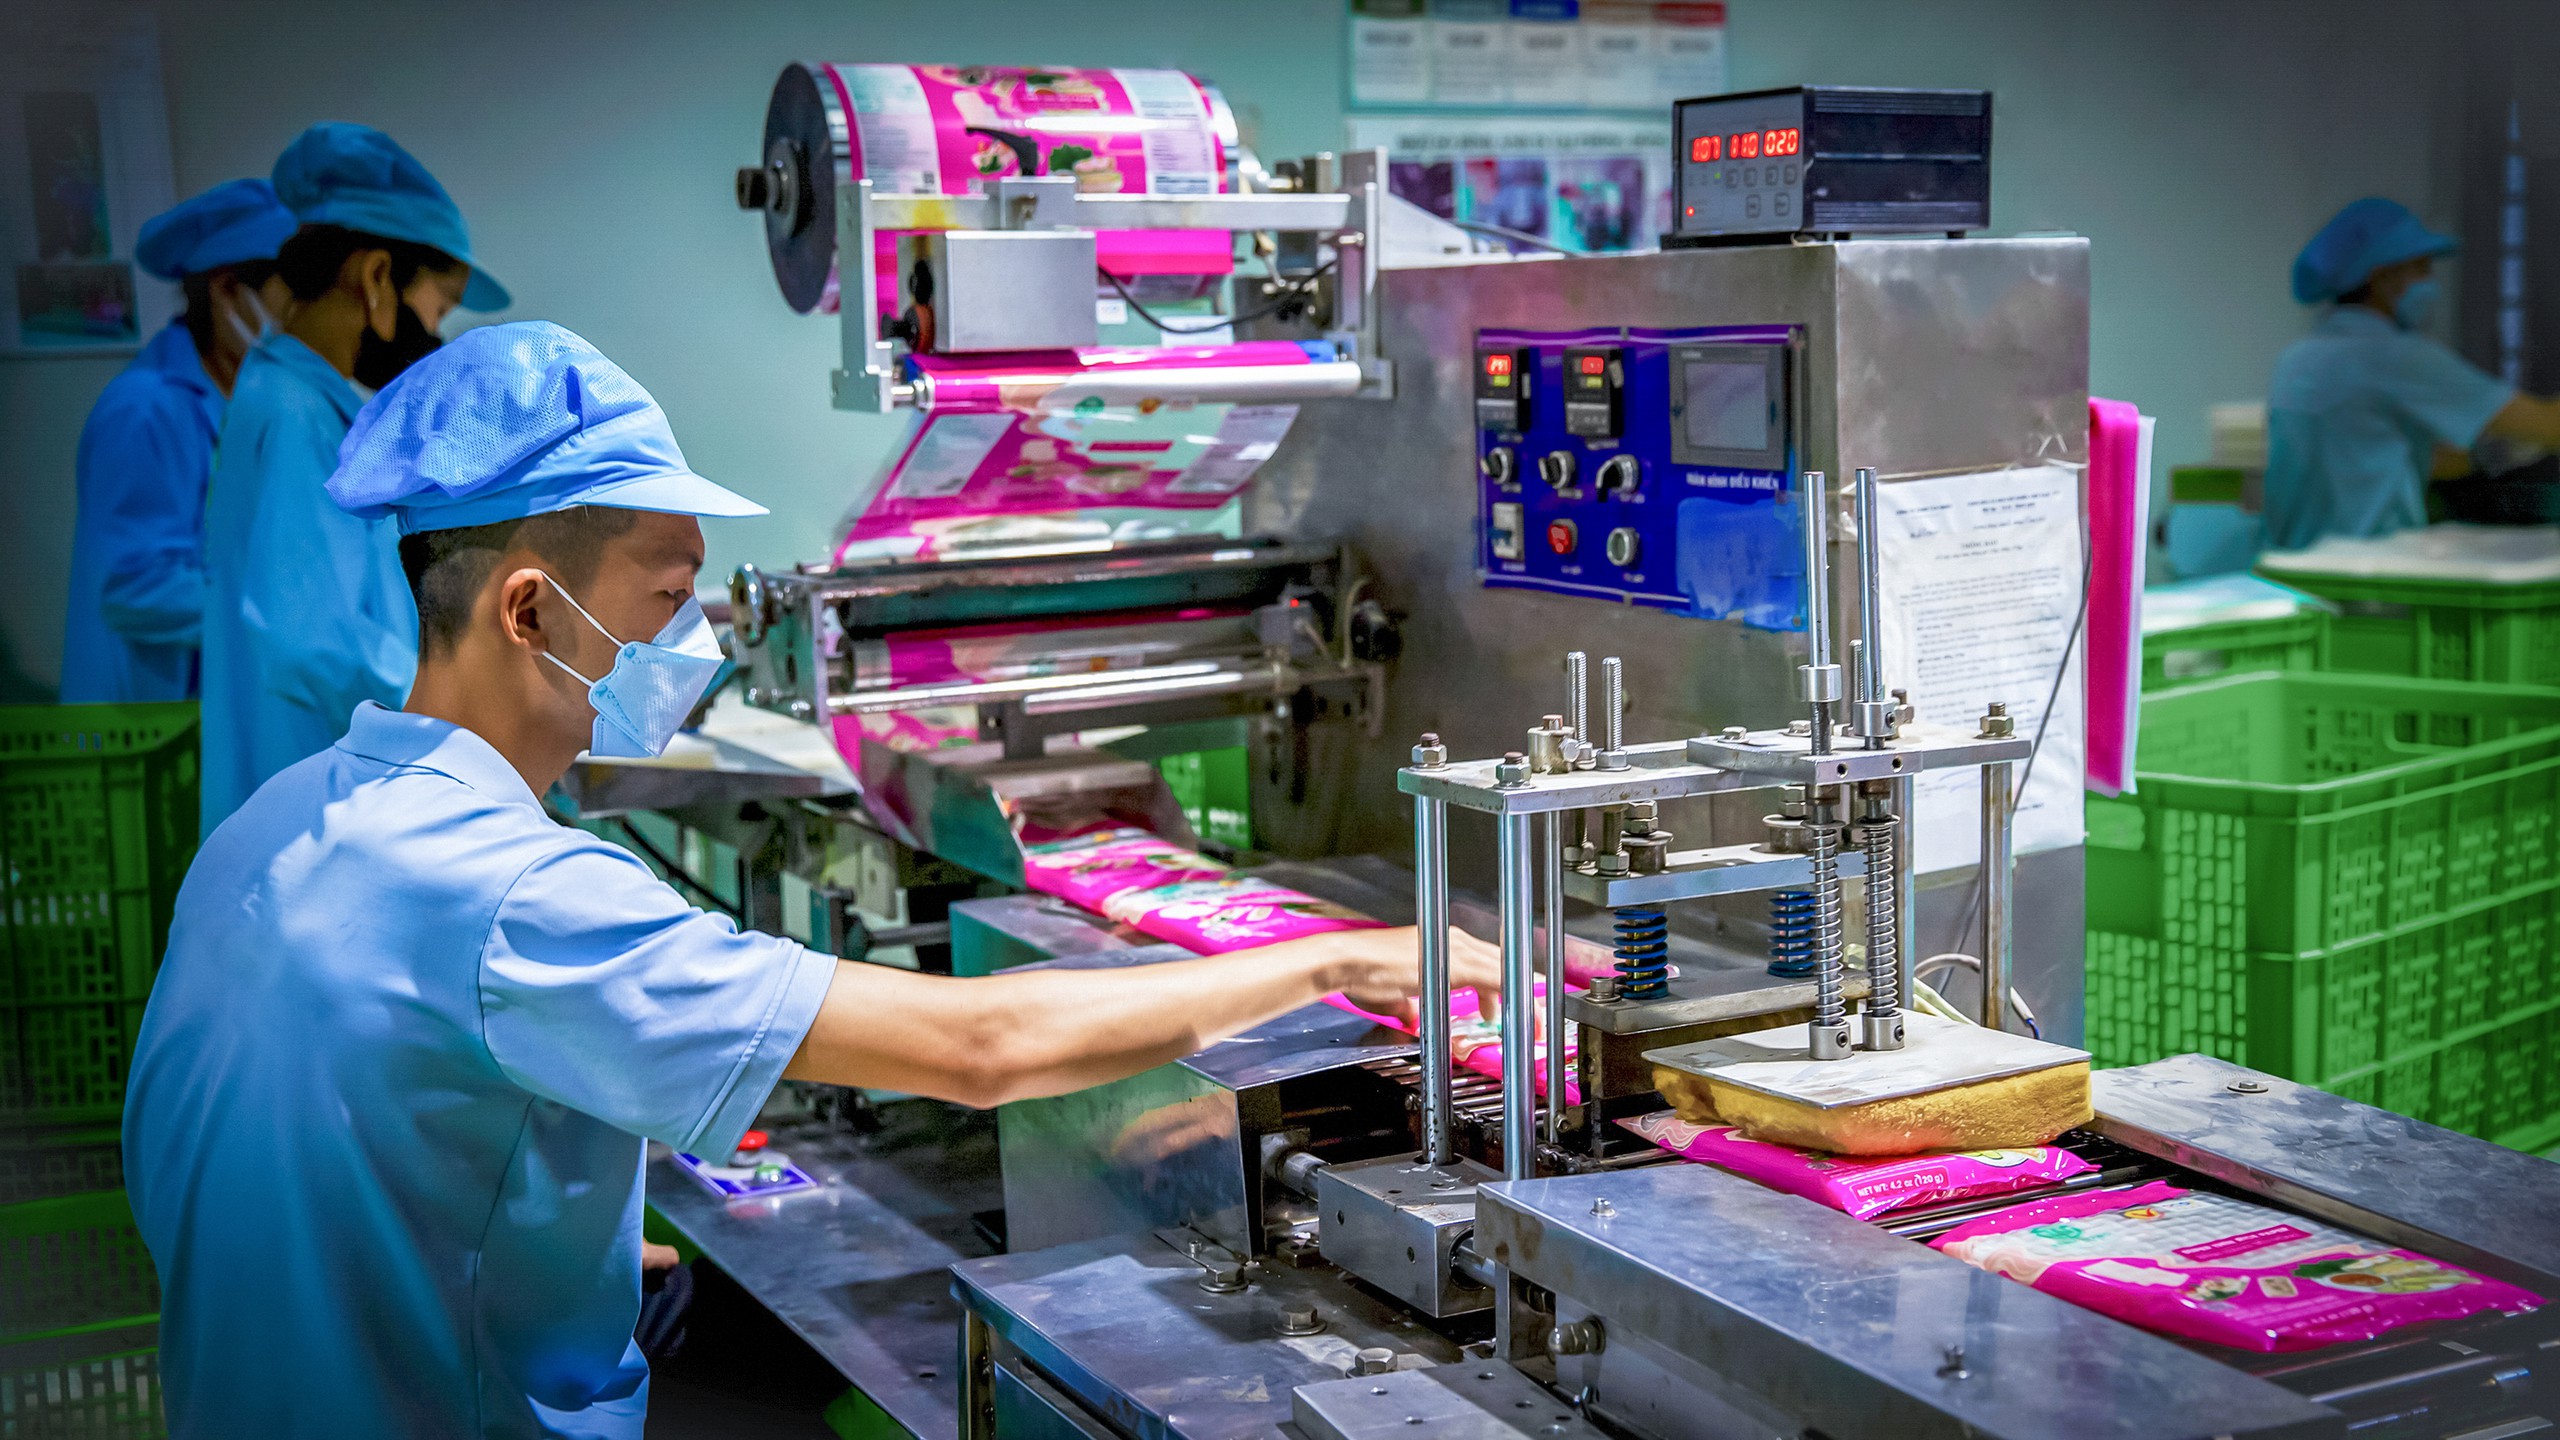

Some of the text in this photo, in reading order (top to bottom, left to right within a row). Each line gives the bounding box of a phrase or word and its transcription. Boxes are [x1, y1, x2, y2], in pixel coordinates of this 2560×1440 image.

[1730, 132, 1759, 158] 110
[1763, 128, 1799, 157] 020
[1857, 1186, 1874, 1198] NET
[1890, 1180, 1903, 1190] 4.2
[1904, 1178, 1913, 1188] oz
[1934, 1173, 1944, 1185] g)
